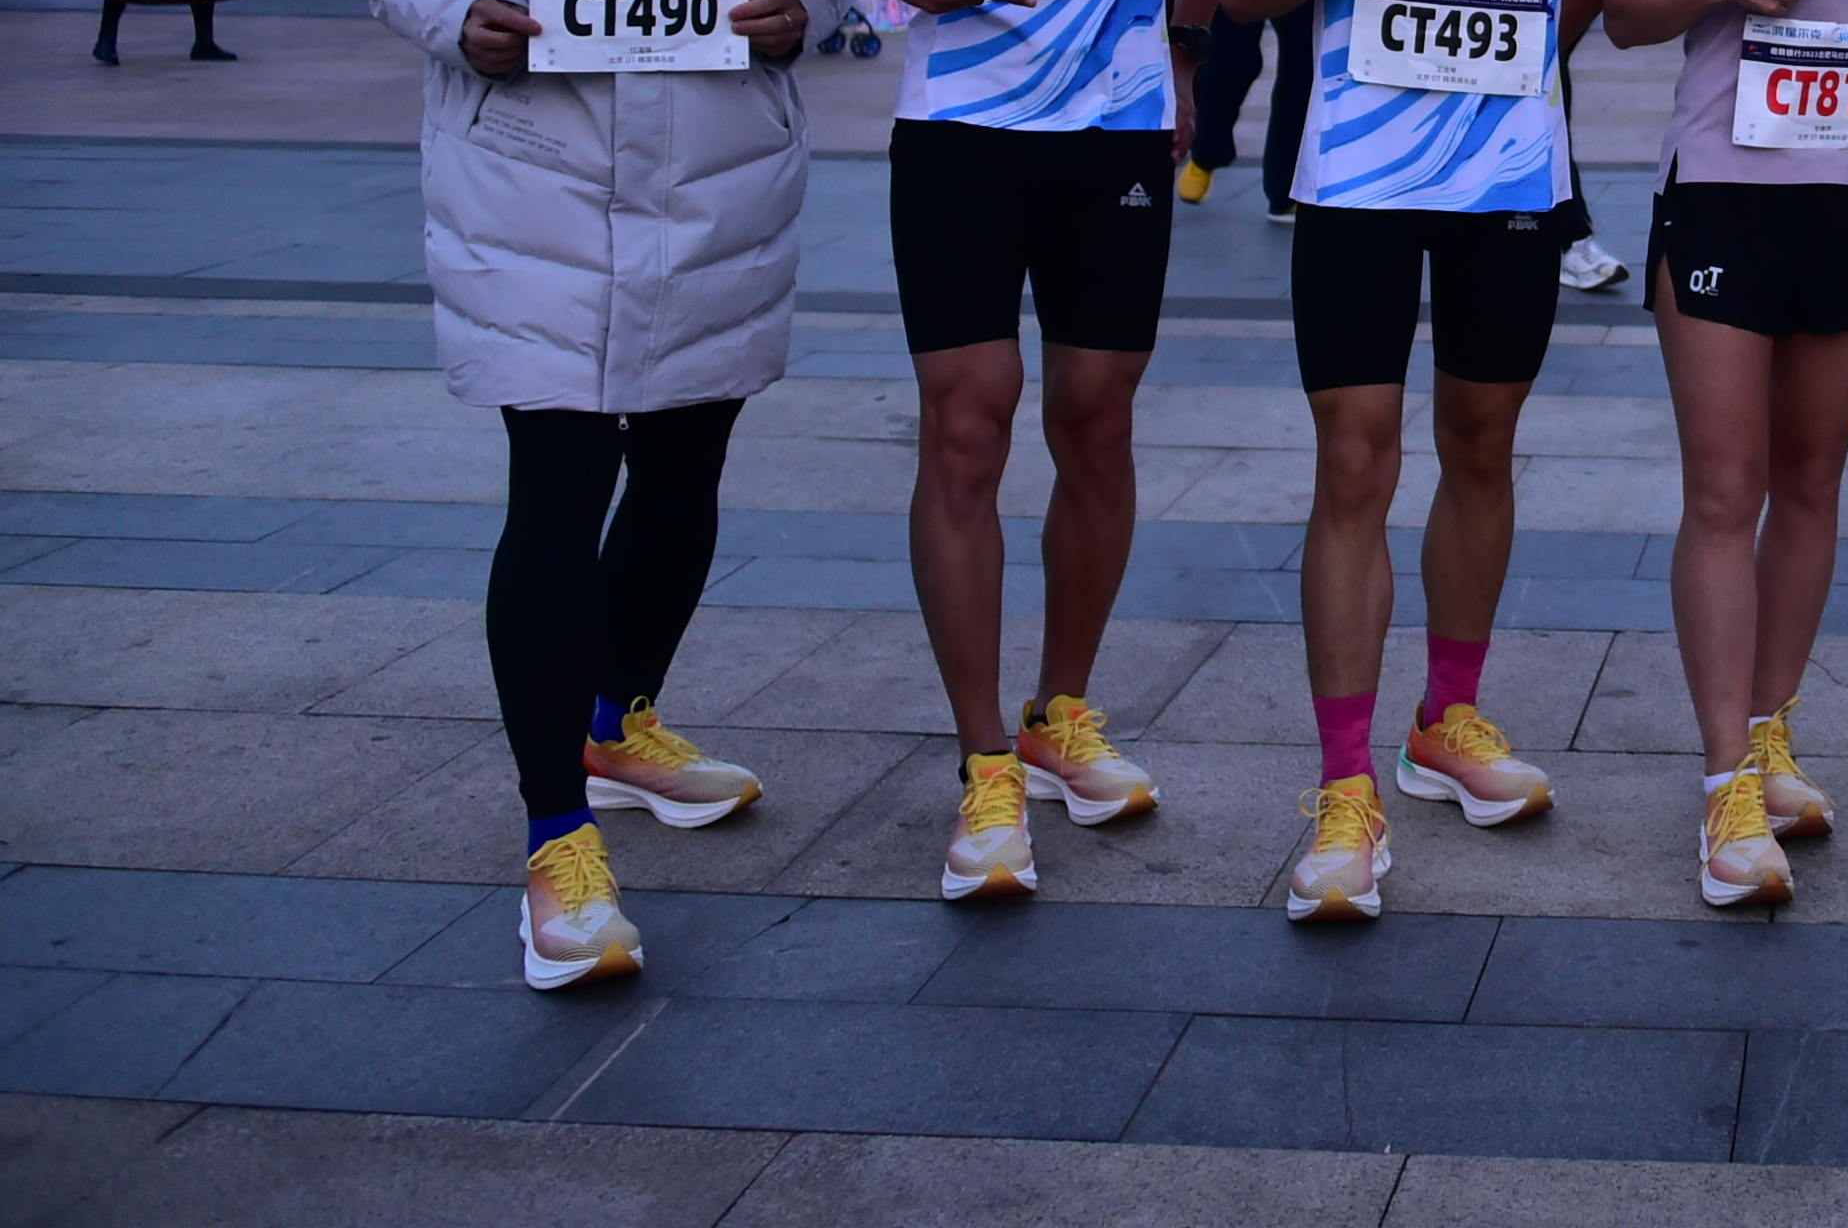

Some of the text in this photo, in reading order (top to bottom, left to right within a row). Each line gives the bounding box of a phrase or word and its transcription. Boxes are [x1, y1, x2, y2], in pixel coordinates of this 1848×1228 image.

[1381, 4, 1518, 61] CT493
[1772, 25, 1821, 39] 鸿星尔克
